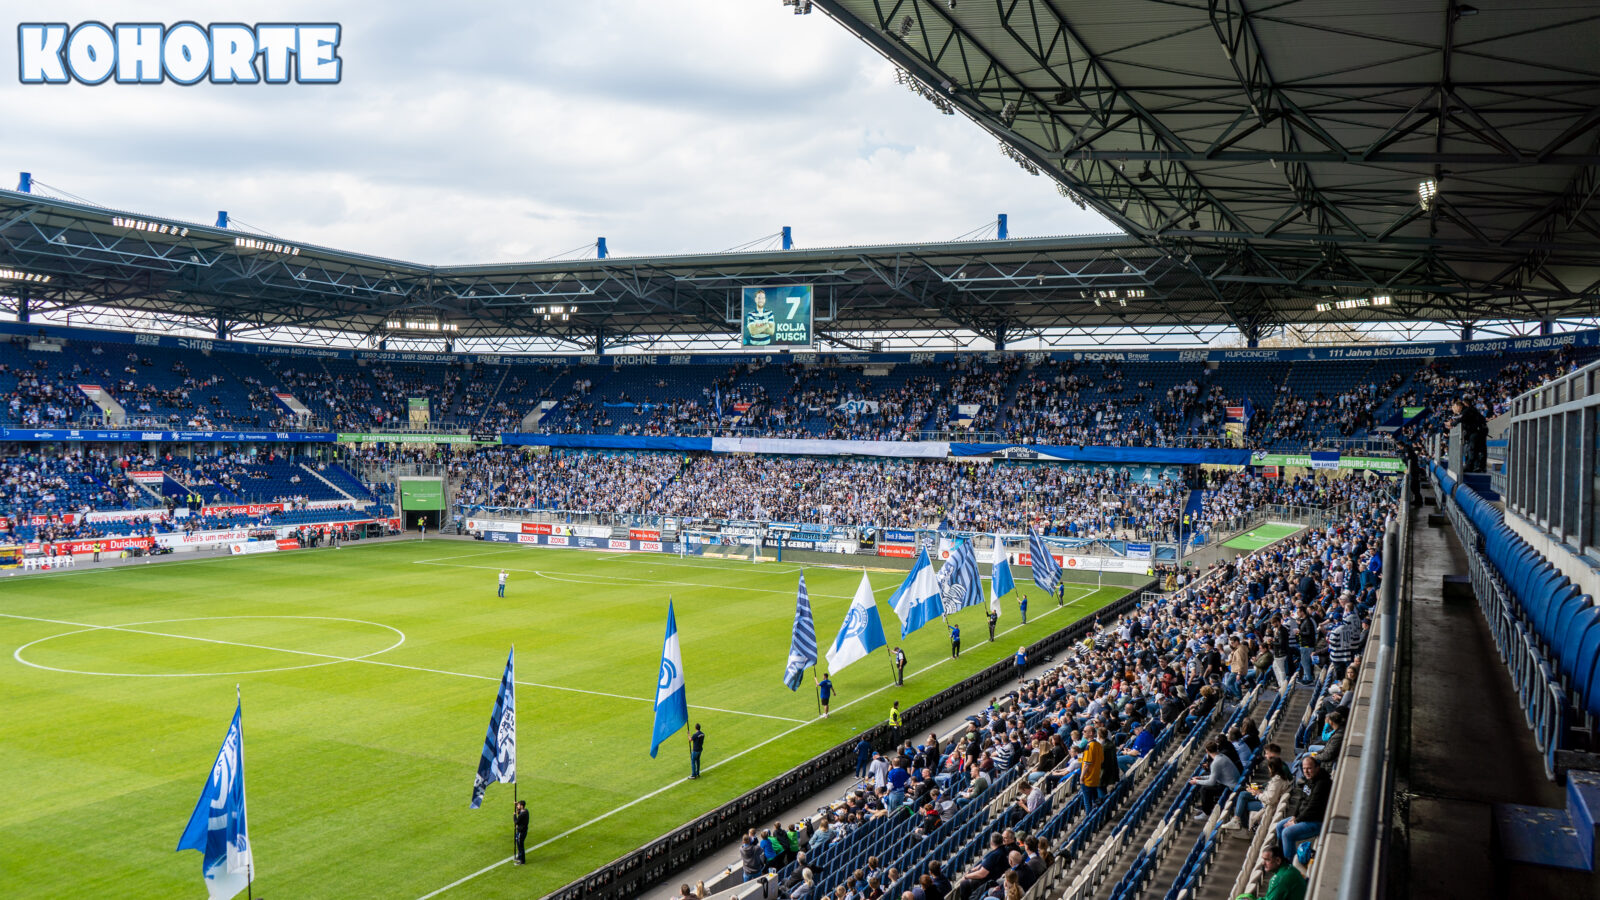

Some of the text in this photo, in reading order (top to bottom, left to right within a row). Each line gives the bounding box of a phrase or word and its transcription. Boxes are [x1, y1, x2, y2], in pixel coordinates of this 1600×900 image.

[785, 296, 801, 320] 7
[776, 322, 806, 332] KOLJA
[775, 332, 807, 342] PUSCH
[189, 340, 213, 350] HTAG
[1465, 341, 1507, 352] 1902-2013
[1514, 339, 1532, 349] WIR
[1532, 337, 1552, 348] SIND
[1553, 334, 1577, 346] DABEI
[1329, 346, 1436, 357] 111 Jahre MSV Duisburg
[613, 355, 658, 364] KROHNE
[1083, 353, 1125, 361] SCANIA
[182, 534, 204, 543] Weil's
[217, 532, 235, 541] mehr
[236, 531, 246, 539] als
[520, 534, 535, 542] ZOXS
[611, 540, 627, 548] ZOXS
[642, 542, 659, 550] ZOXS
